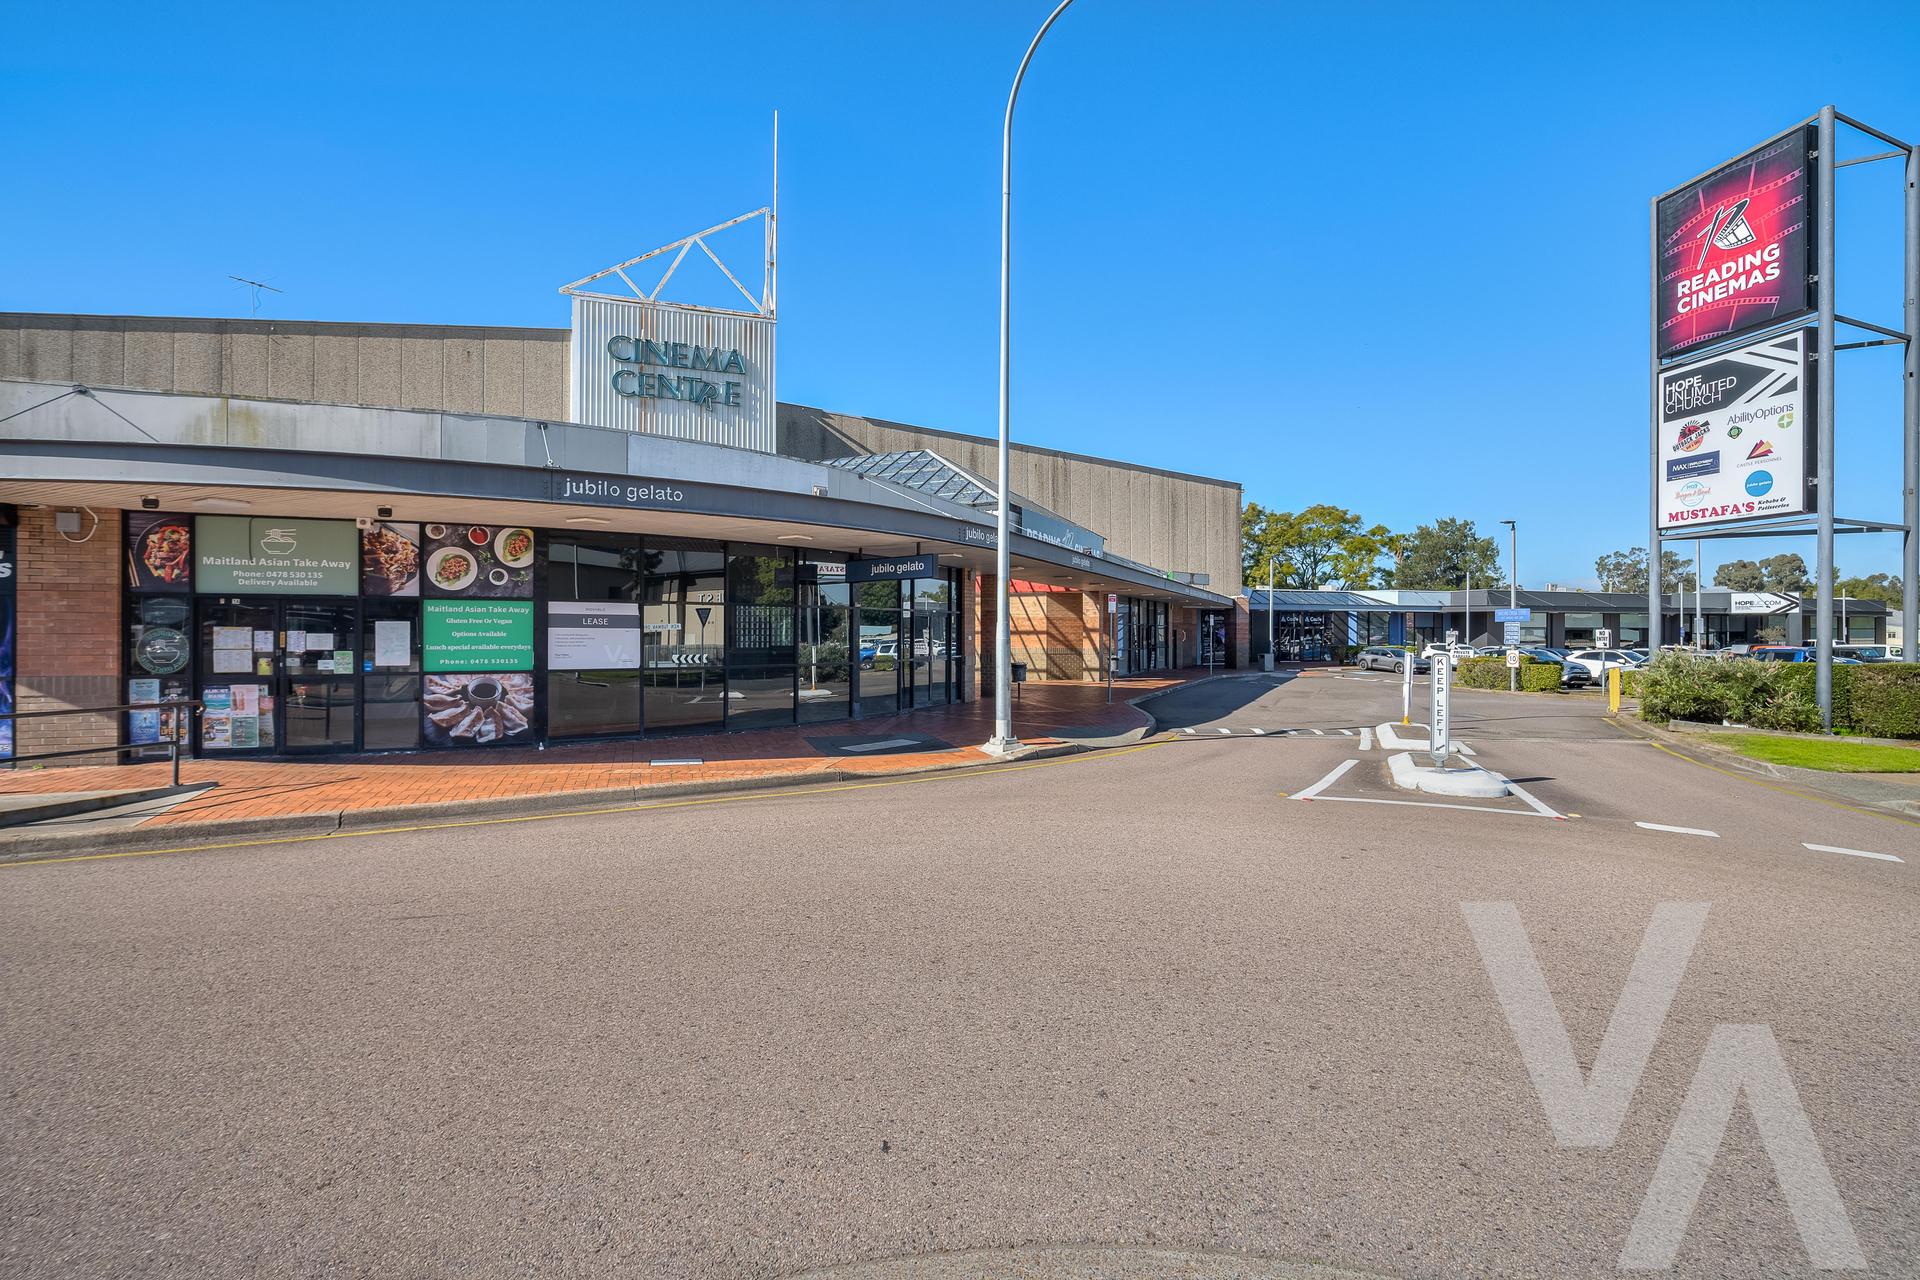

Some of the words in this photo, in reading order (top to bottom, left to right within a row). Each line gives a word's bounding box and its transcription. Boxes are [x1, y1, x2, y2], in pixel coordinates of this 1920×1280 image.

[1677, 243, 1780, 298] READING
[1677, 262, 1780, 314] CINEMAS
[607, 335, 745, 375] CINEMA
[611, 369, 741, 411] CENTRE
[1665, 375, 1702, 395] HOPE
[1666, 376, 1737, 404] UNLIMITED
[1665, 391, 1722, 414] CHURCH
[1727, 403, 1794, 426] AbilityOptions
[1694, 426, 1711, 439] JACKS
[1672, 463, 1688, 472] MAX
[1754, 456, 1782, 465] PERSONNEL
[563, 478, 621, 497] jubilo
[626, 485, 683, 502] gelato
[1758, 498, 1779, 506] Kebabs
[1758, 503, 1790, 511] Patisseries
[1668, 501, 1755, 523] MUSTAFA'S
[966, 526, 985, 540] jubilo
[986, 532, 998, 544] gela
[202, 556, 256, 566] Maitland
[258, 558, 291, 568] Asian
[292, 558, 319, 568] Take
[320, 559, 352, 570] Away
[870, 563, 895, 576] jubilo
[896, 561, 925, 574] gelato
[232, 570, 264, 578] Phone:
[238, 578, 276, 587] Delivery
[277, 579, 318, 587] Available
[427, 605, 464, 613] Maitland
[508, 606, 530, 614] Away
[583, 618, 608, 626] LEASE
